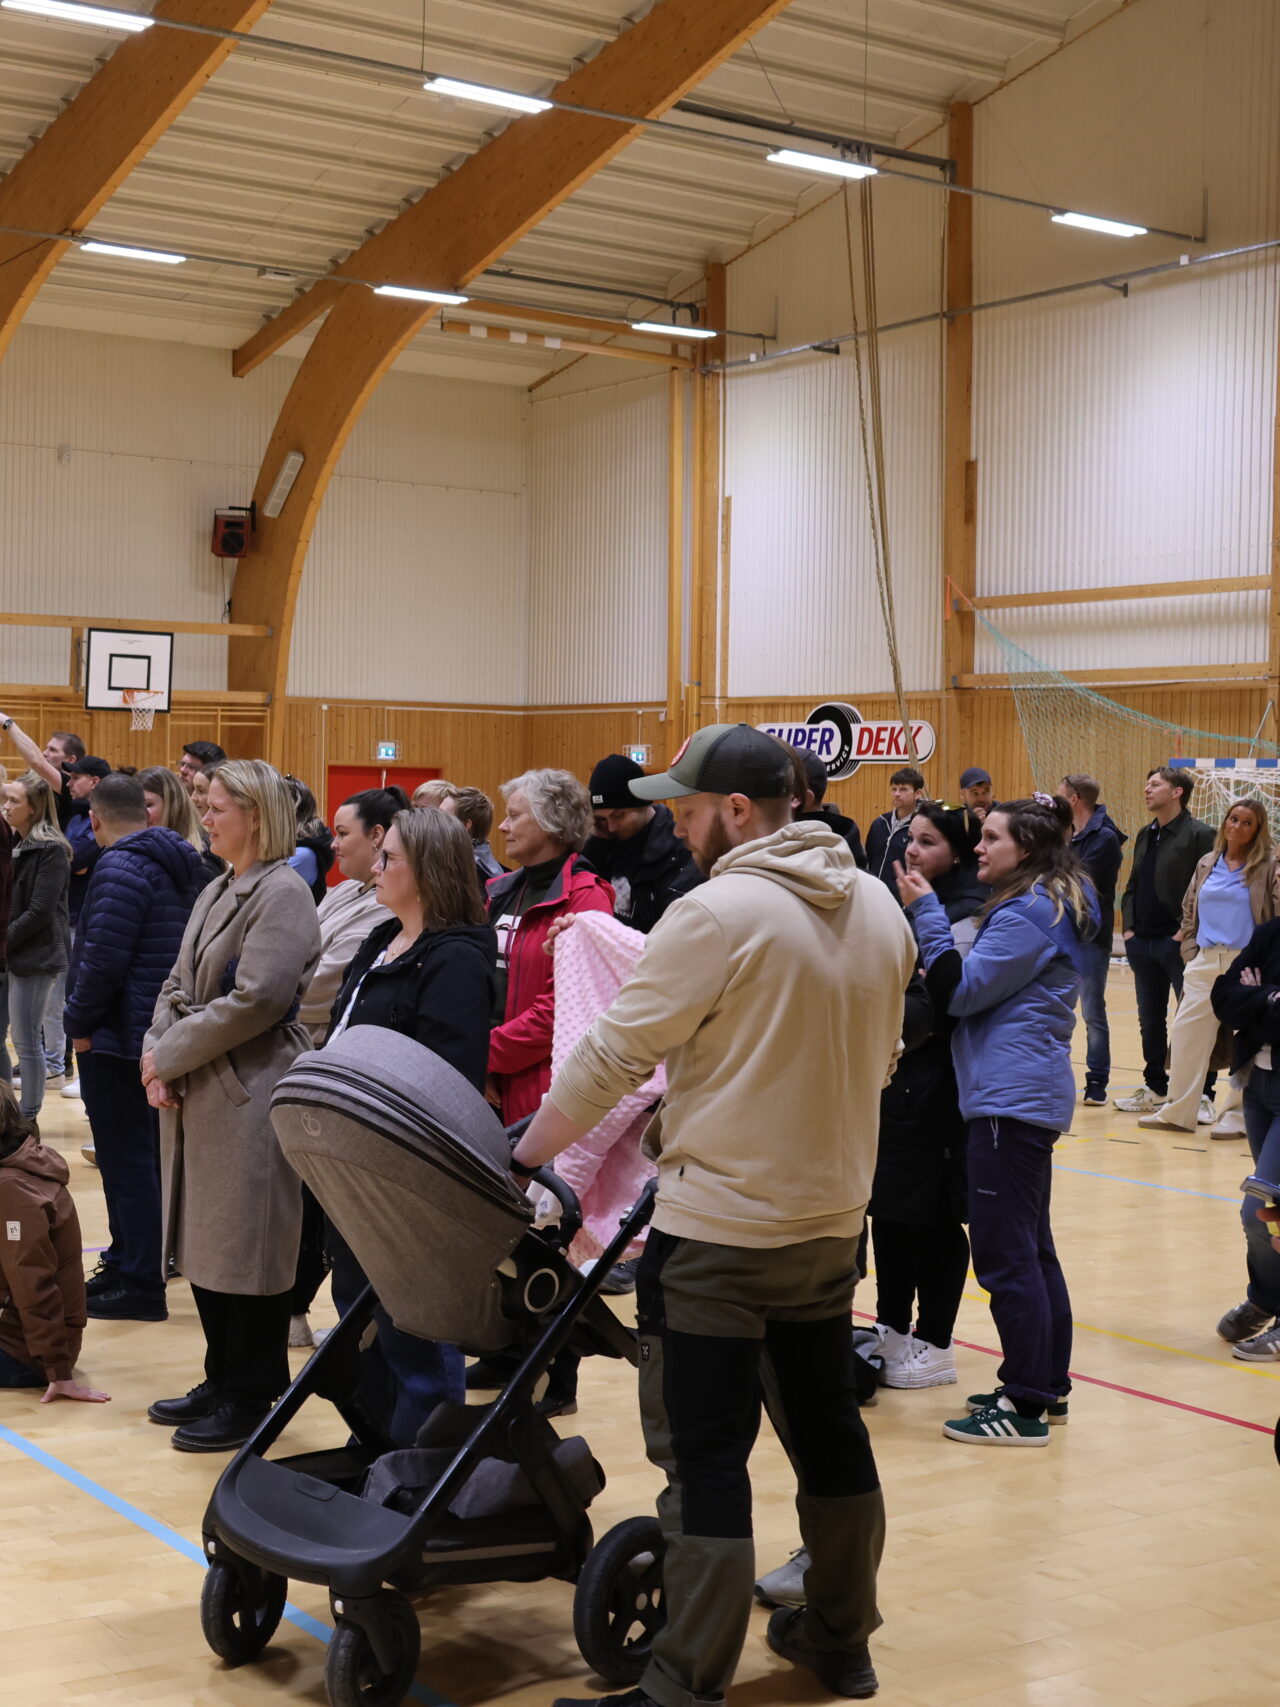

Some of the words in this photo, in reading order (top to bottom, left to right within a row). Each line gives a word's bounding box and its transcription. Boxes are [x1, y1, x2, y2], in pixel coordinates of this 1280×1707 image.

[766, 727, 835, 755] PER
[856, 726, 923, 756] DEKK
[825, 744, 850, 772] ERVICE
